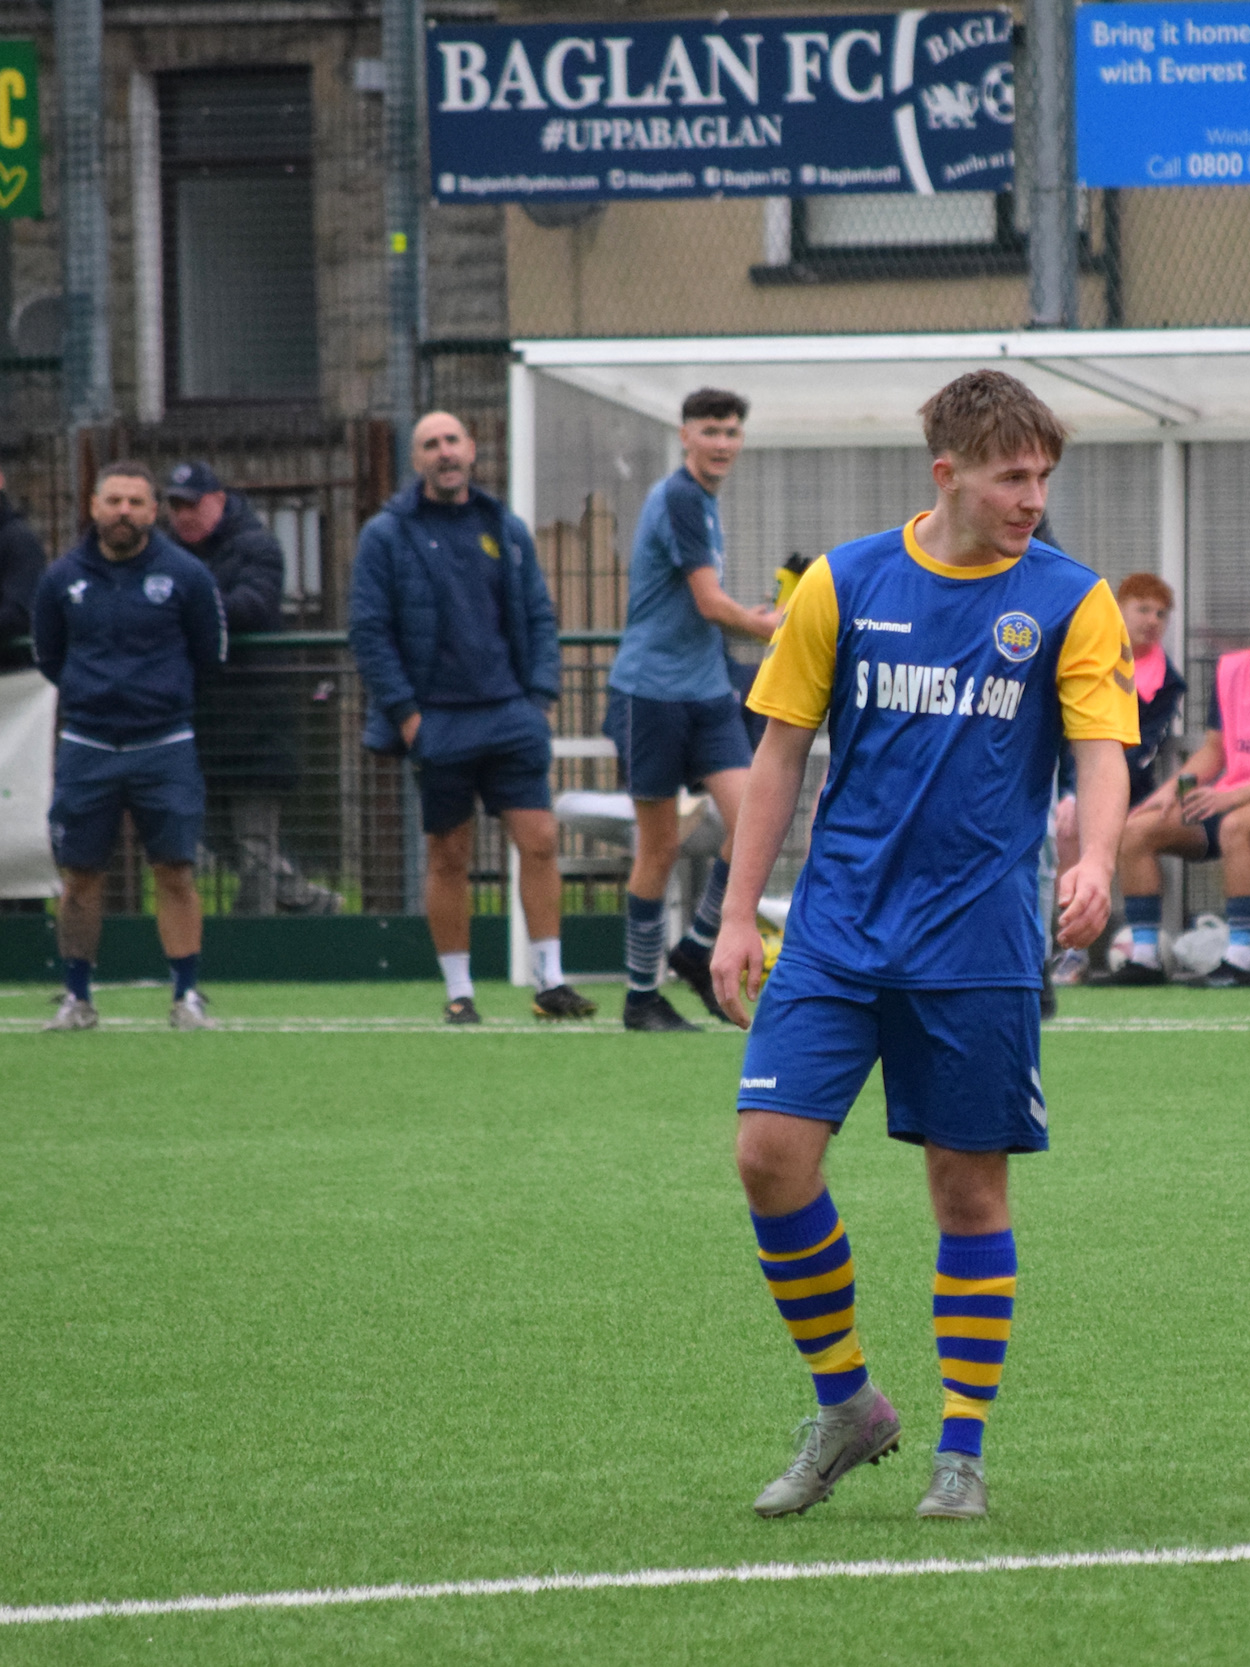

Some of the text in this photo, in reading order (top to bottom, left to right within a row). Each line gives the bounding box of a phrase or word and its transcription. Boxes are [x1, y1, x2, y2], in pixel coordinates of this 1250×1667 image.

[1092, 20, 1155, 52] Bring
[1161, 20, 1179, 45] it
[437, 29, 884, 111] BAGLAN FC
[1101, 57, 1246, 84] with Everest
[540, 115, 783, 152] #UPPABAGLAN
[1148, 154, 1181, 178] Call
[1187, 152, 1243, 178] 0800
[867, 618, 913, 634] hummel
[856, 660, 869, 709] S
[876, 662, 958, 715] DAVIES
[958, 676, 975, 716] &
